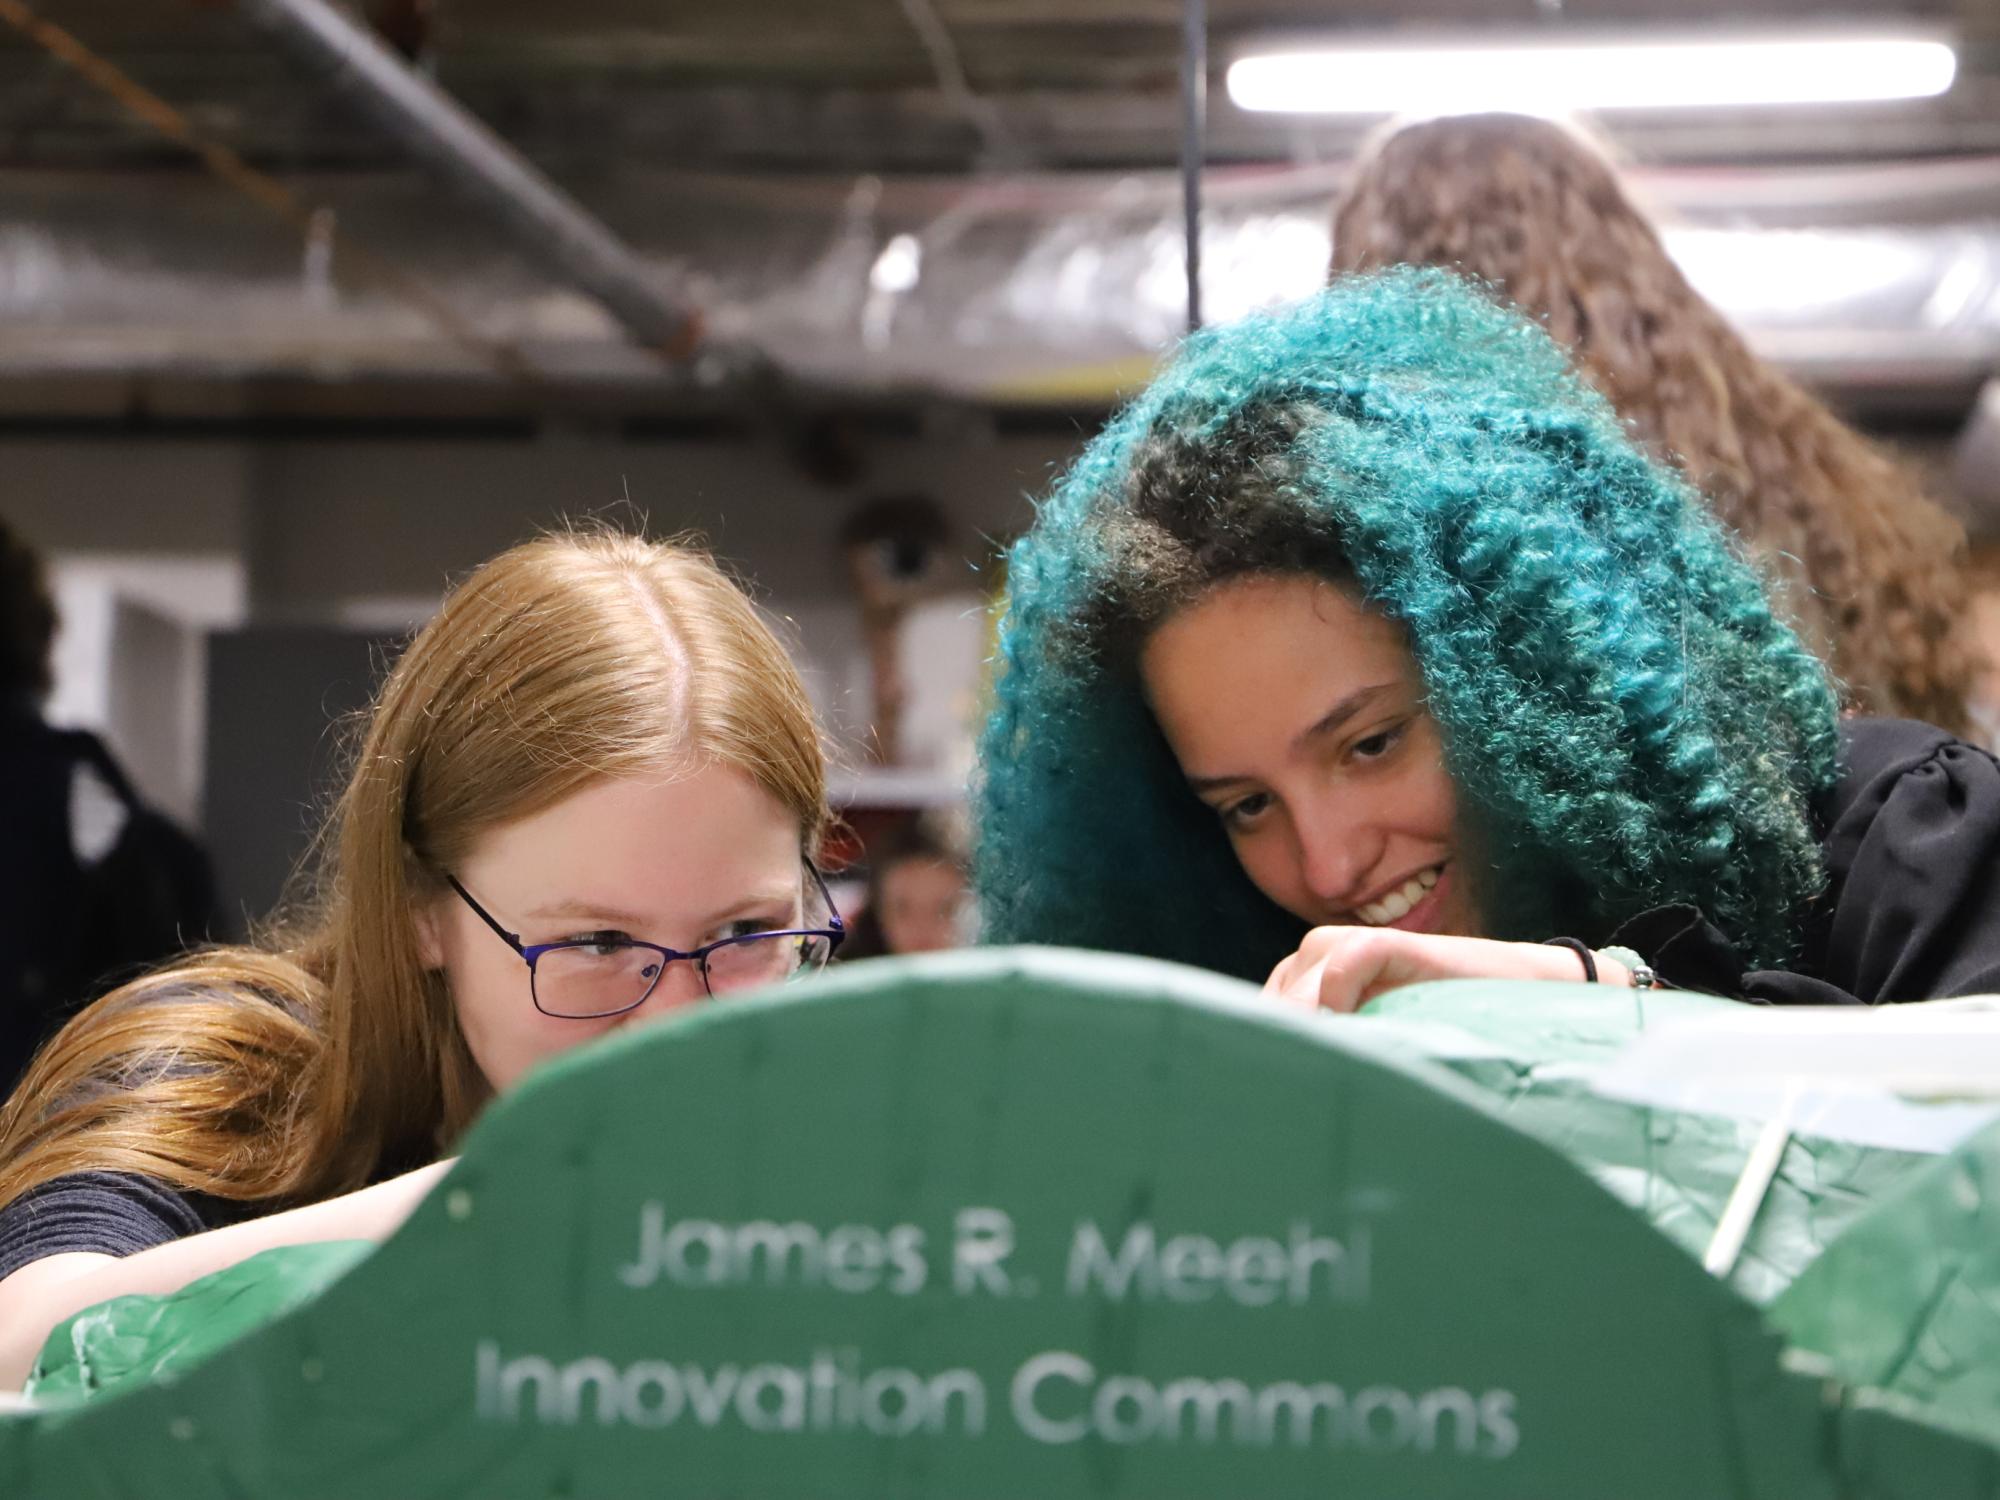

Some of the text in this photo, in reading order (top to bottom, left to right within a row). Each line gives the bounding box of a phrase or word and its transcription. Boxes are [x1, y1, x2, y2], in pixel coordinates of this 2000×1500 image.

[619, 1202, 927, 1294] James
[1067, 1218, 1371, 1305] Meehl
[475, 1341, 1520, 1458] Innovation Commons
